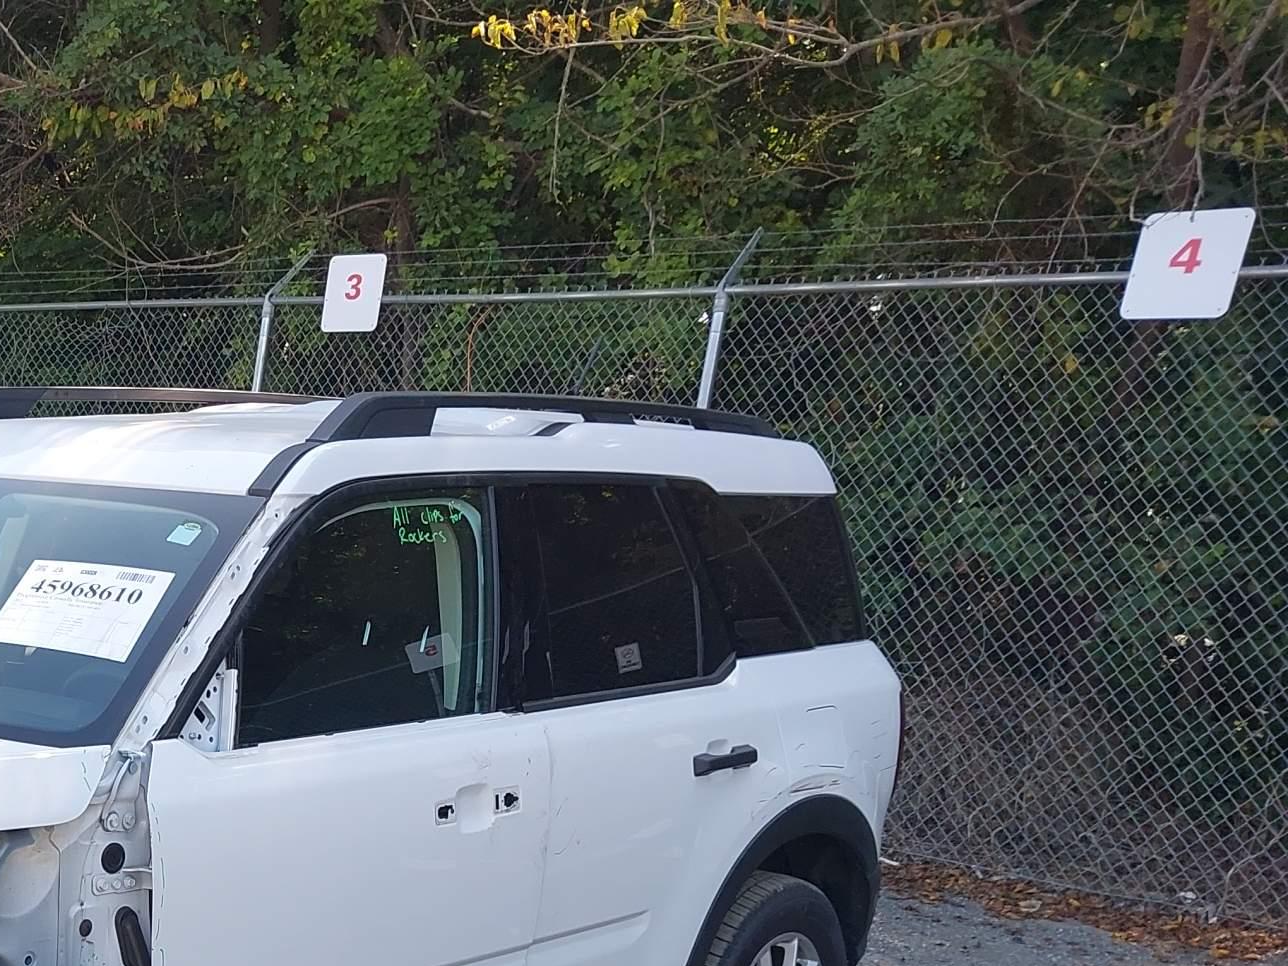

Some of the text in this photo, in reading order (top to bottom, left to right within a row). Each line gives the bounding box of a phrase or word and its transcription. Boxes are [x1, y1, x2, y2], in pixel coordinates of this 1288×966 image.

[1168, 238, 1203, 274] 4
[344, 273, 363, 301] 3
[393, 505, 410, 529] All
[398, 526, 447, 545] Rockers
[30, 578, 143, 605] 45968610
